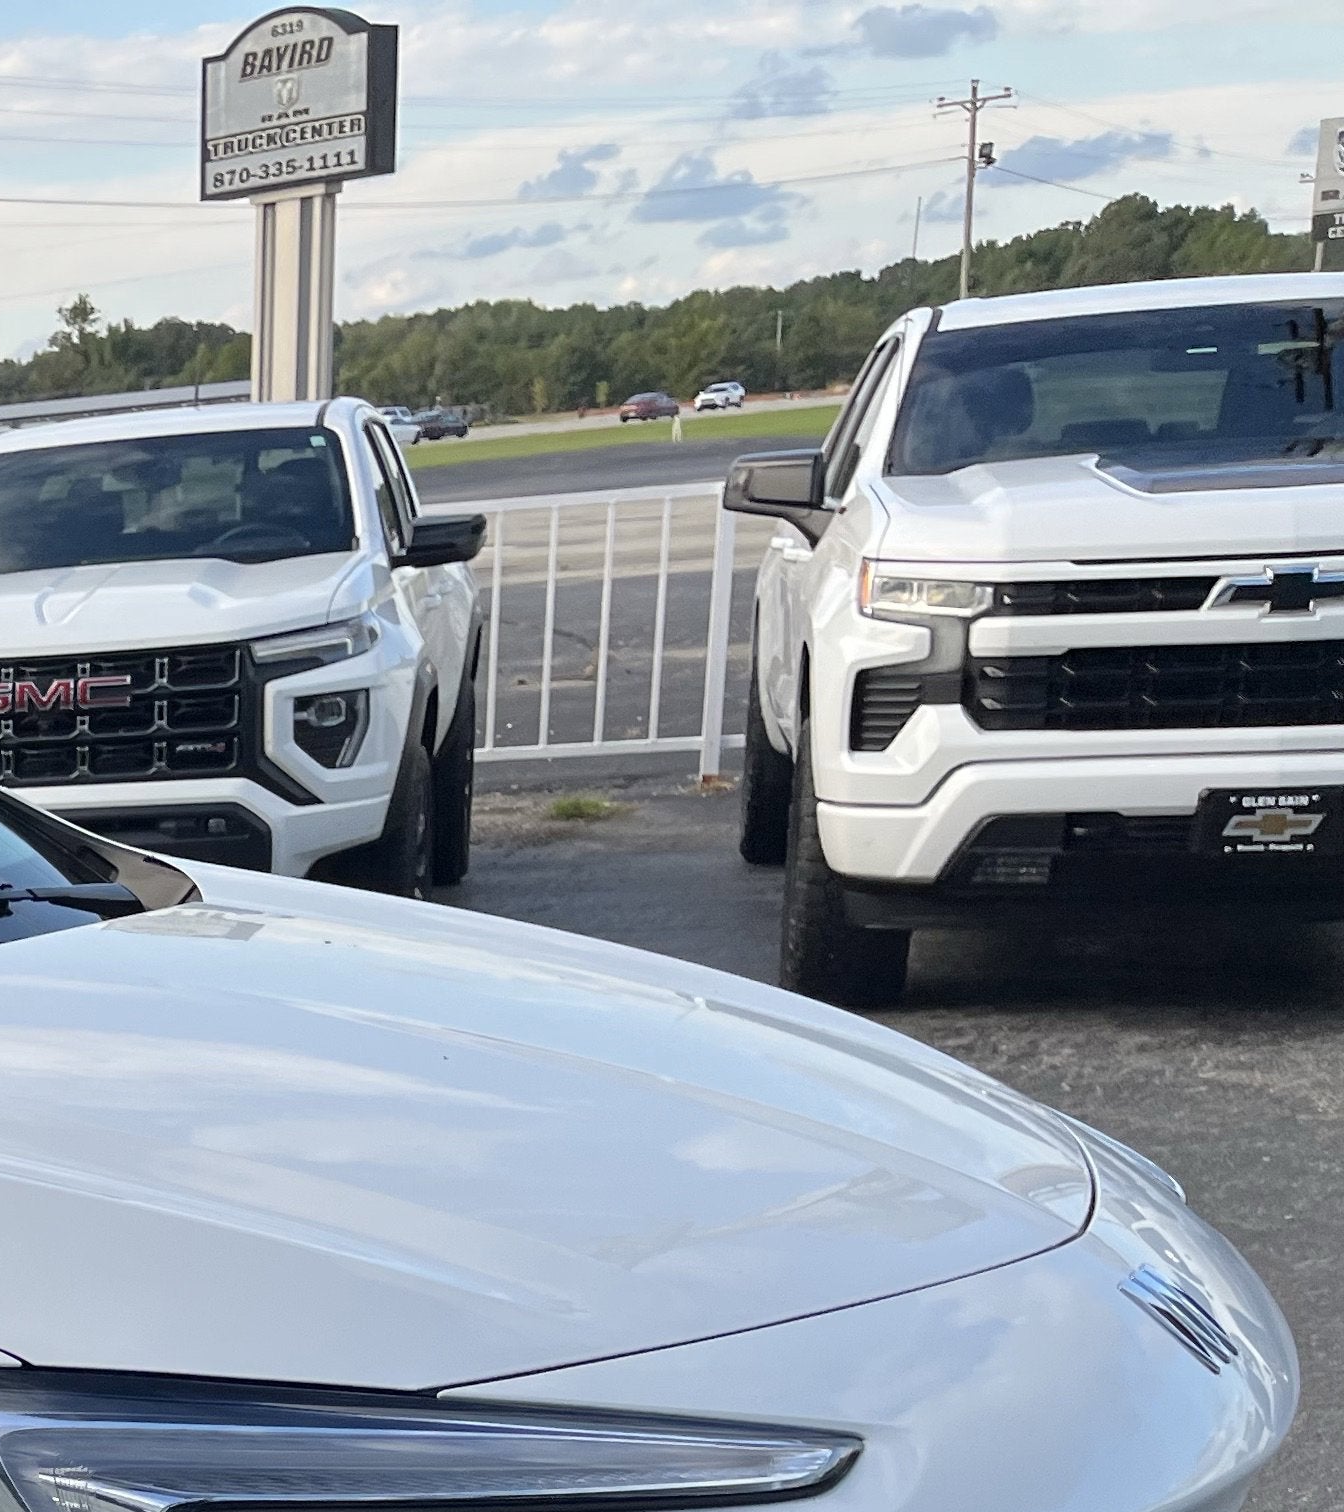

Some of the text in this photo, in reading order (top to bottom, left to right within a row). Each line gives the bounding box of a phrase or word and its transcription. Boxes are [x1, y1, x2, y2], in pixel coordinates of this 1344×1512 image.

[240, 36, 334, 79] BAYIRD
[210, 117, 363, 158] TRUCK CENTER
[212, 149, 359, 189] 870-335-1111
